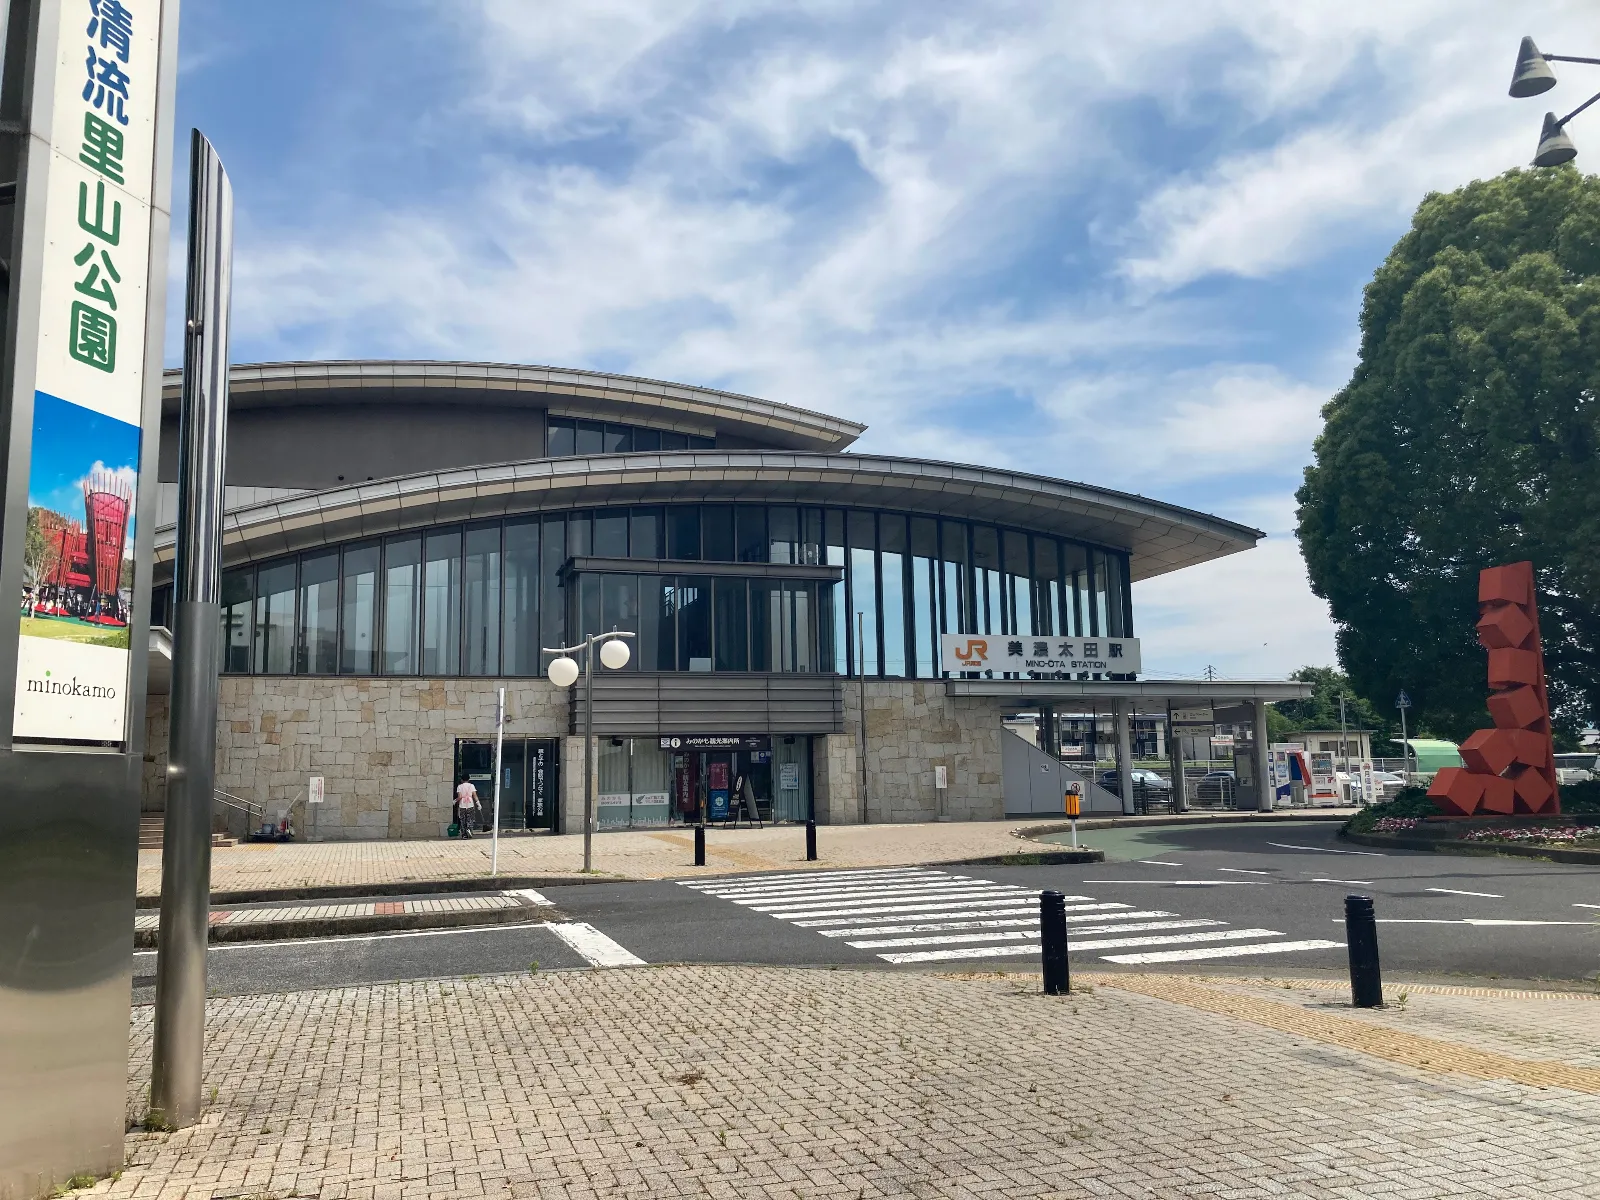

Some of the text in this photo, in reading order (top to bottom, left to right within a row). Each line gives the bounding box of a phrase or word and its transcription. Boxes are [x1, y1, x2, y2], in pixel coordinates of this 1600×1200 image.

[69, 0, 133, 374] 清流里山公園
[955, 639, 989, 660] JR
[1007, 640, 1123, 658] 美濃太田駅
[1071, 660, 1107, 669] STATION
[26, 670, 116, 699] minokamo
